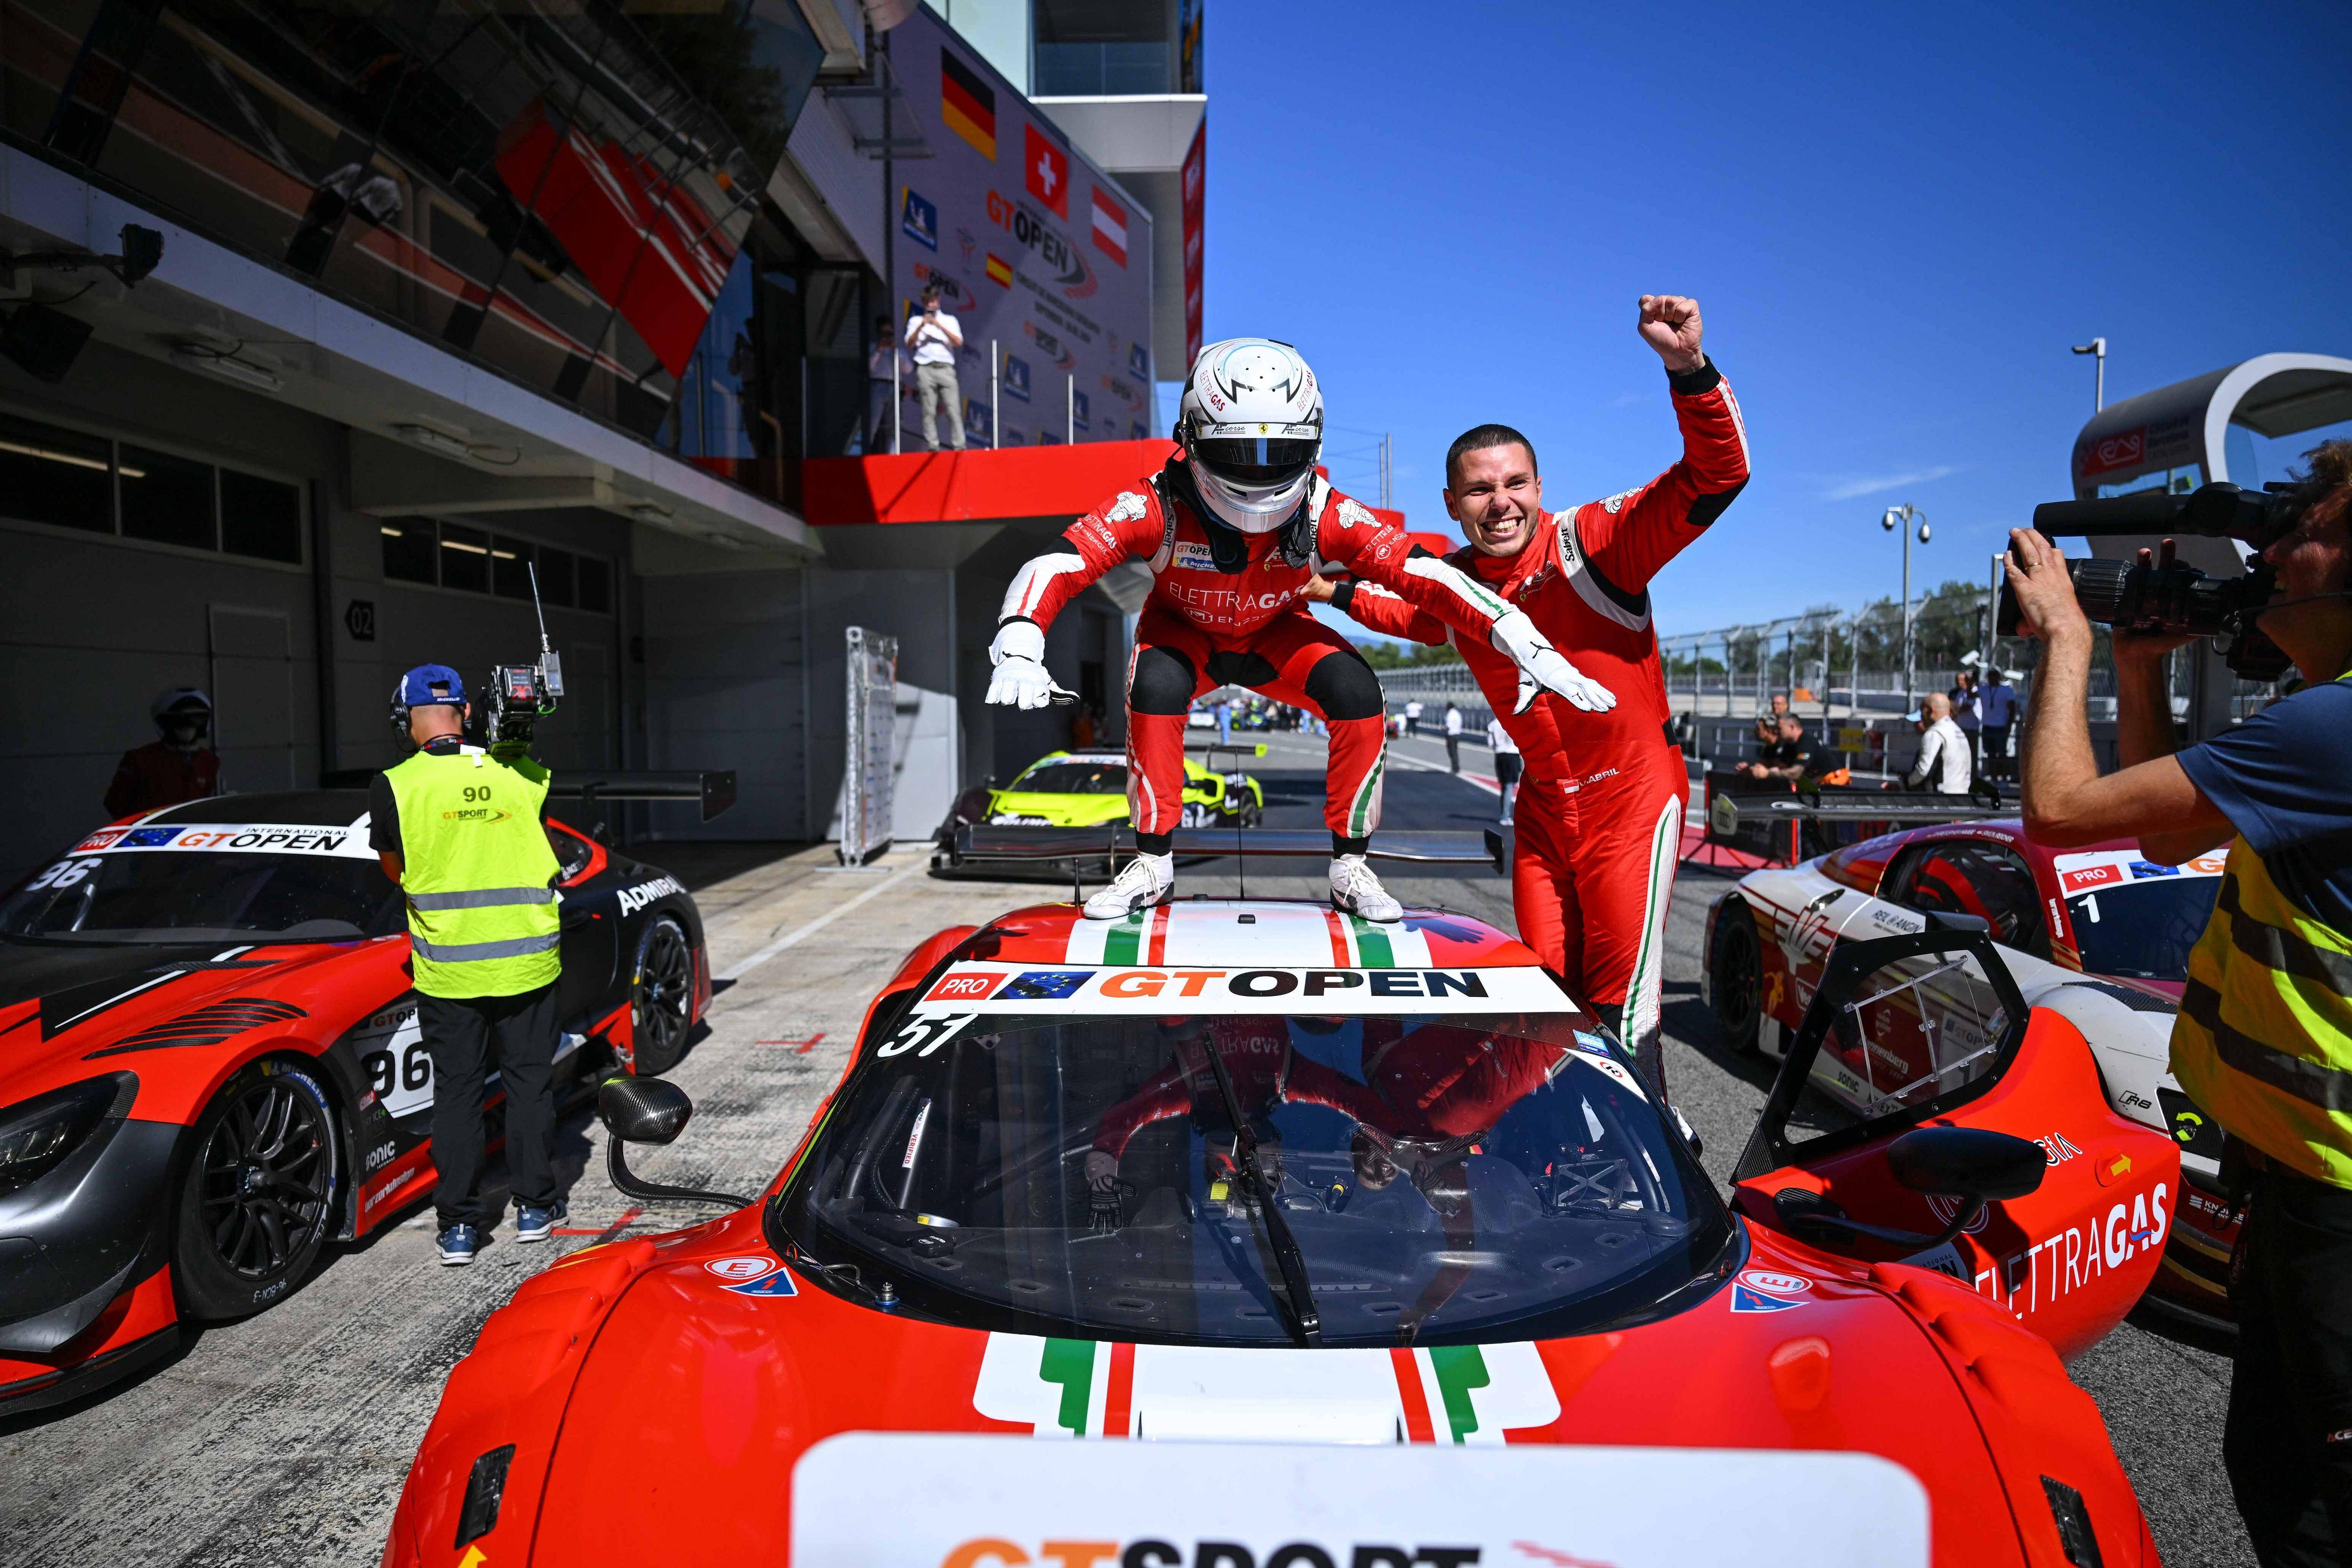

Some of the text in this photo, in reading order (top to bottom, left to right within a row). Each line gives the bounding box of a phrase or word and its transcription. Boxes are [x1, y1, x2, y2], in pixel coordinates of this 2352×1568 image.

[1200, 370, 1226, 412] ELETTRAGAS
[1297, 370, 1313, 411] ELETTRAGAS
[1163, 513, 1175, 549] Sabelt
[1565, 527, 1575, 561] Sabelt
[463, 786, 491, 803] 90
[443, 808, 488, 820] GTSPORT
[85, 833, 119, 848] PRO
[245, 828, 349, 836] INTERNATIONAL
[25, 857, 103, 892] 96
[2073, 868, 2107, 883] PRO
[2078, 894, 2100, 923] 1
[939, 979, 989, 994] PRO
[373, 1008, 416, 1027] GTOP
[877, 1013, 979, 1058] 51
[360, 1041, 430, 1099] 96
[2128, 1096, 2152, 1109] R8
[905, 1134, 918, 1164] VERIFIED
[727, 1263, 752, 1272] E
[1760, 1272, 1791, 1288] E
